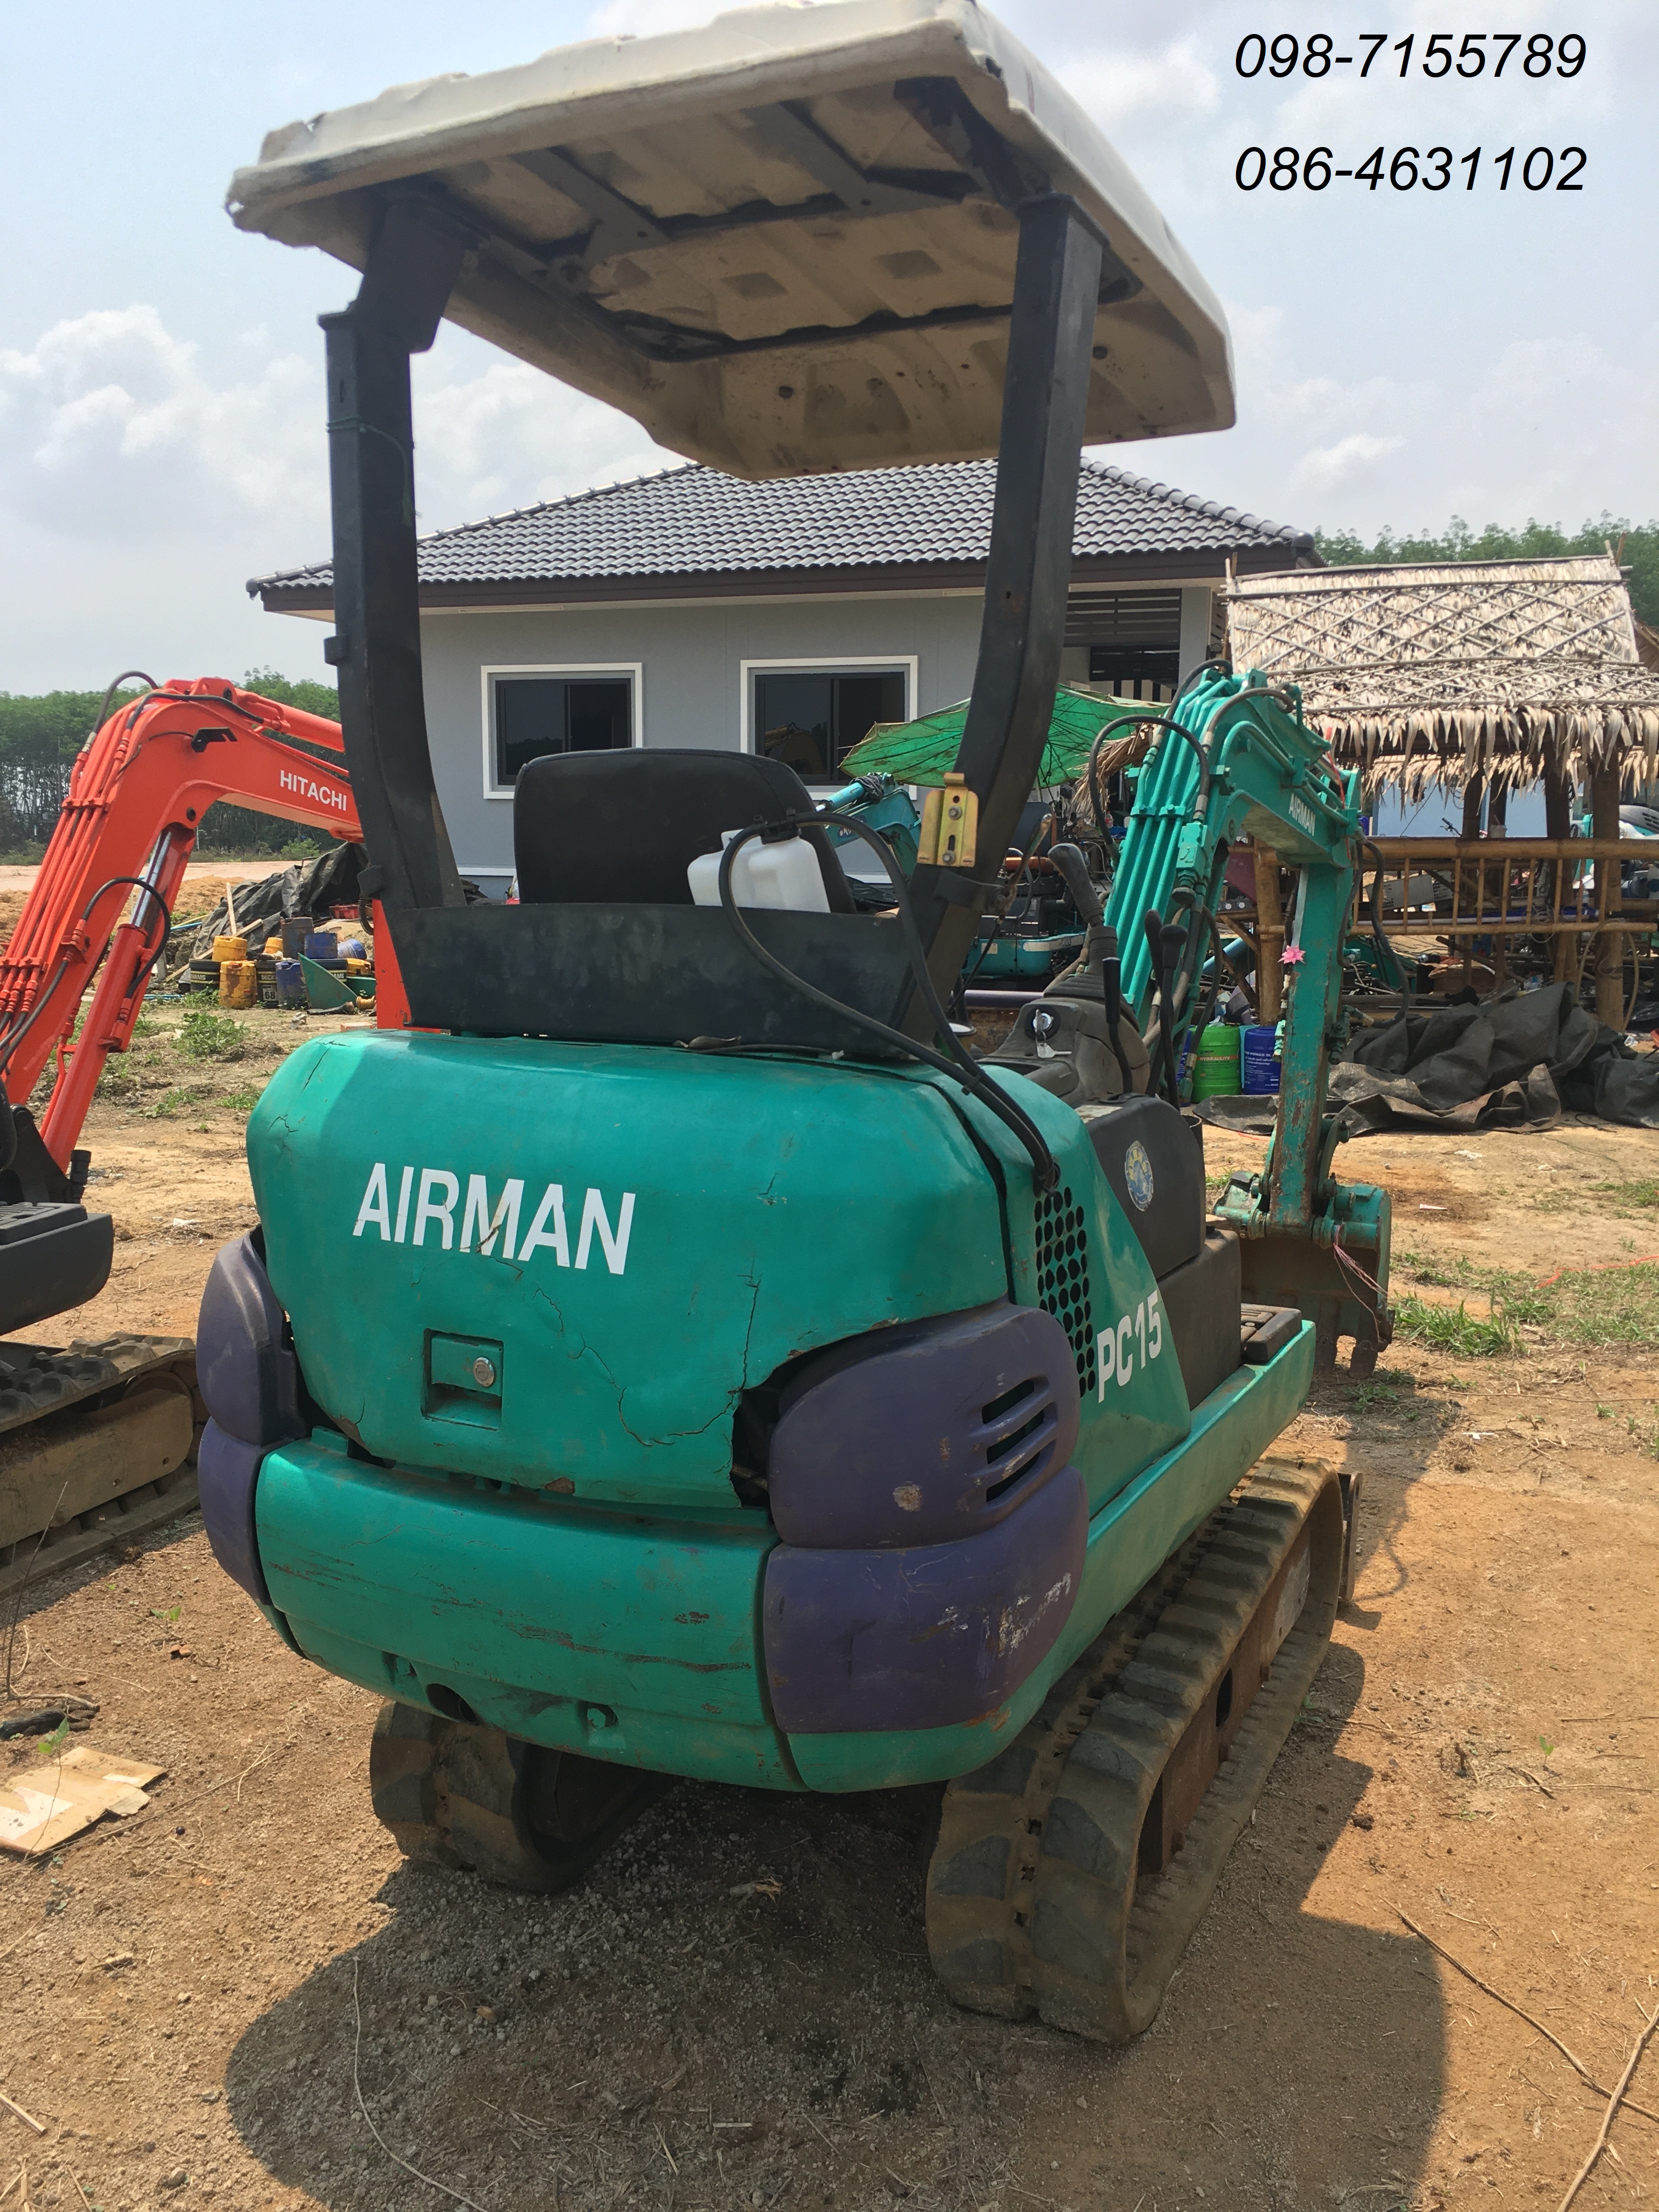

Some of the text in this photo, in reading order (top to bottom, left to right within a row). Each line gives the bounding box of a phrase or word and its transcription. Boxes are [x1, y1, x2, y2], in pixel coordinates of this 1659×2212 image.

[280, 769, 347, 811] HITACHI
[1288, 793, 1316, 837] AIRMAN
[265, 991, 275, 1000] 68
[352, 1163, 636, 1276] AIRMAN
[1097, 1289, 1162, 1404] PC15
